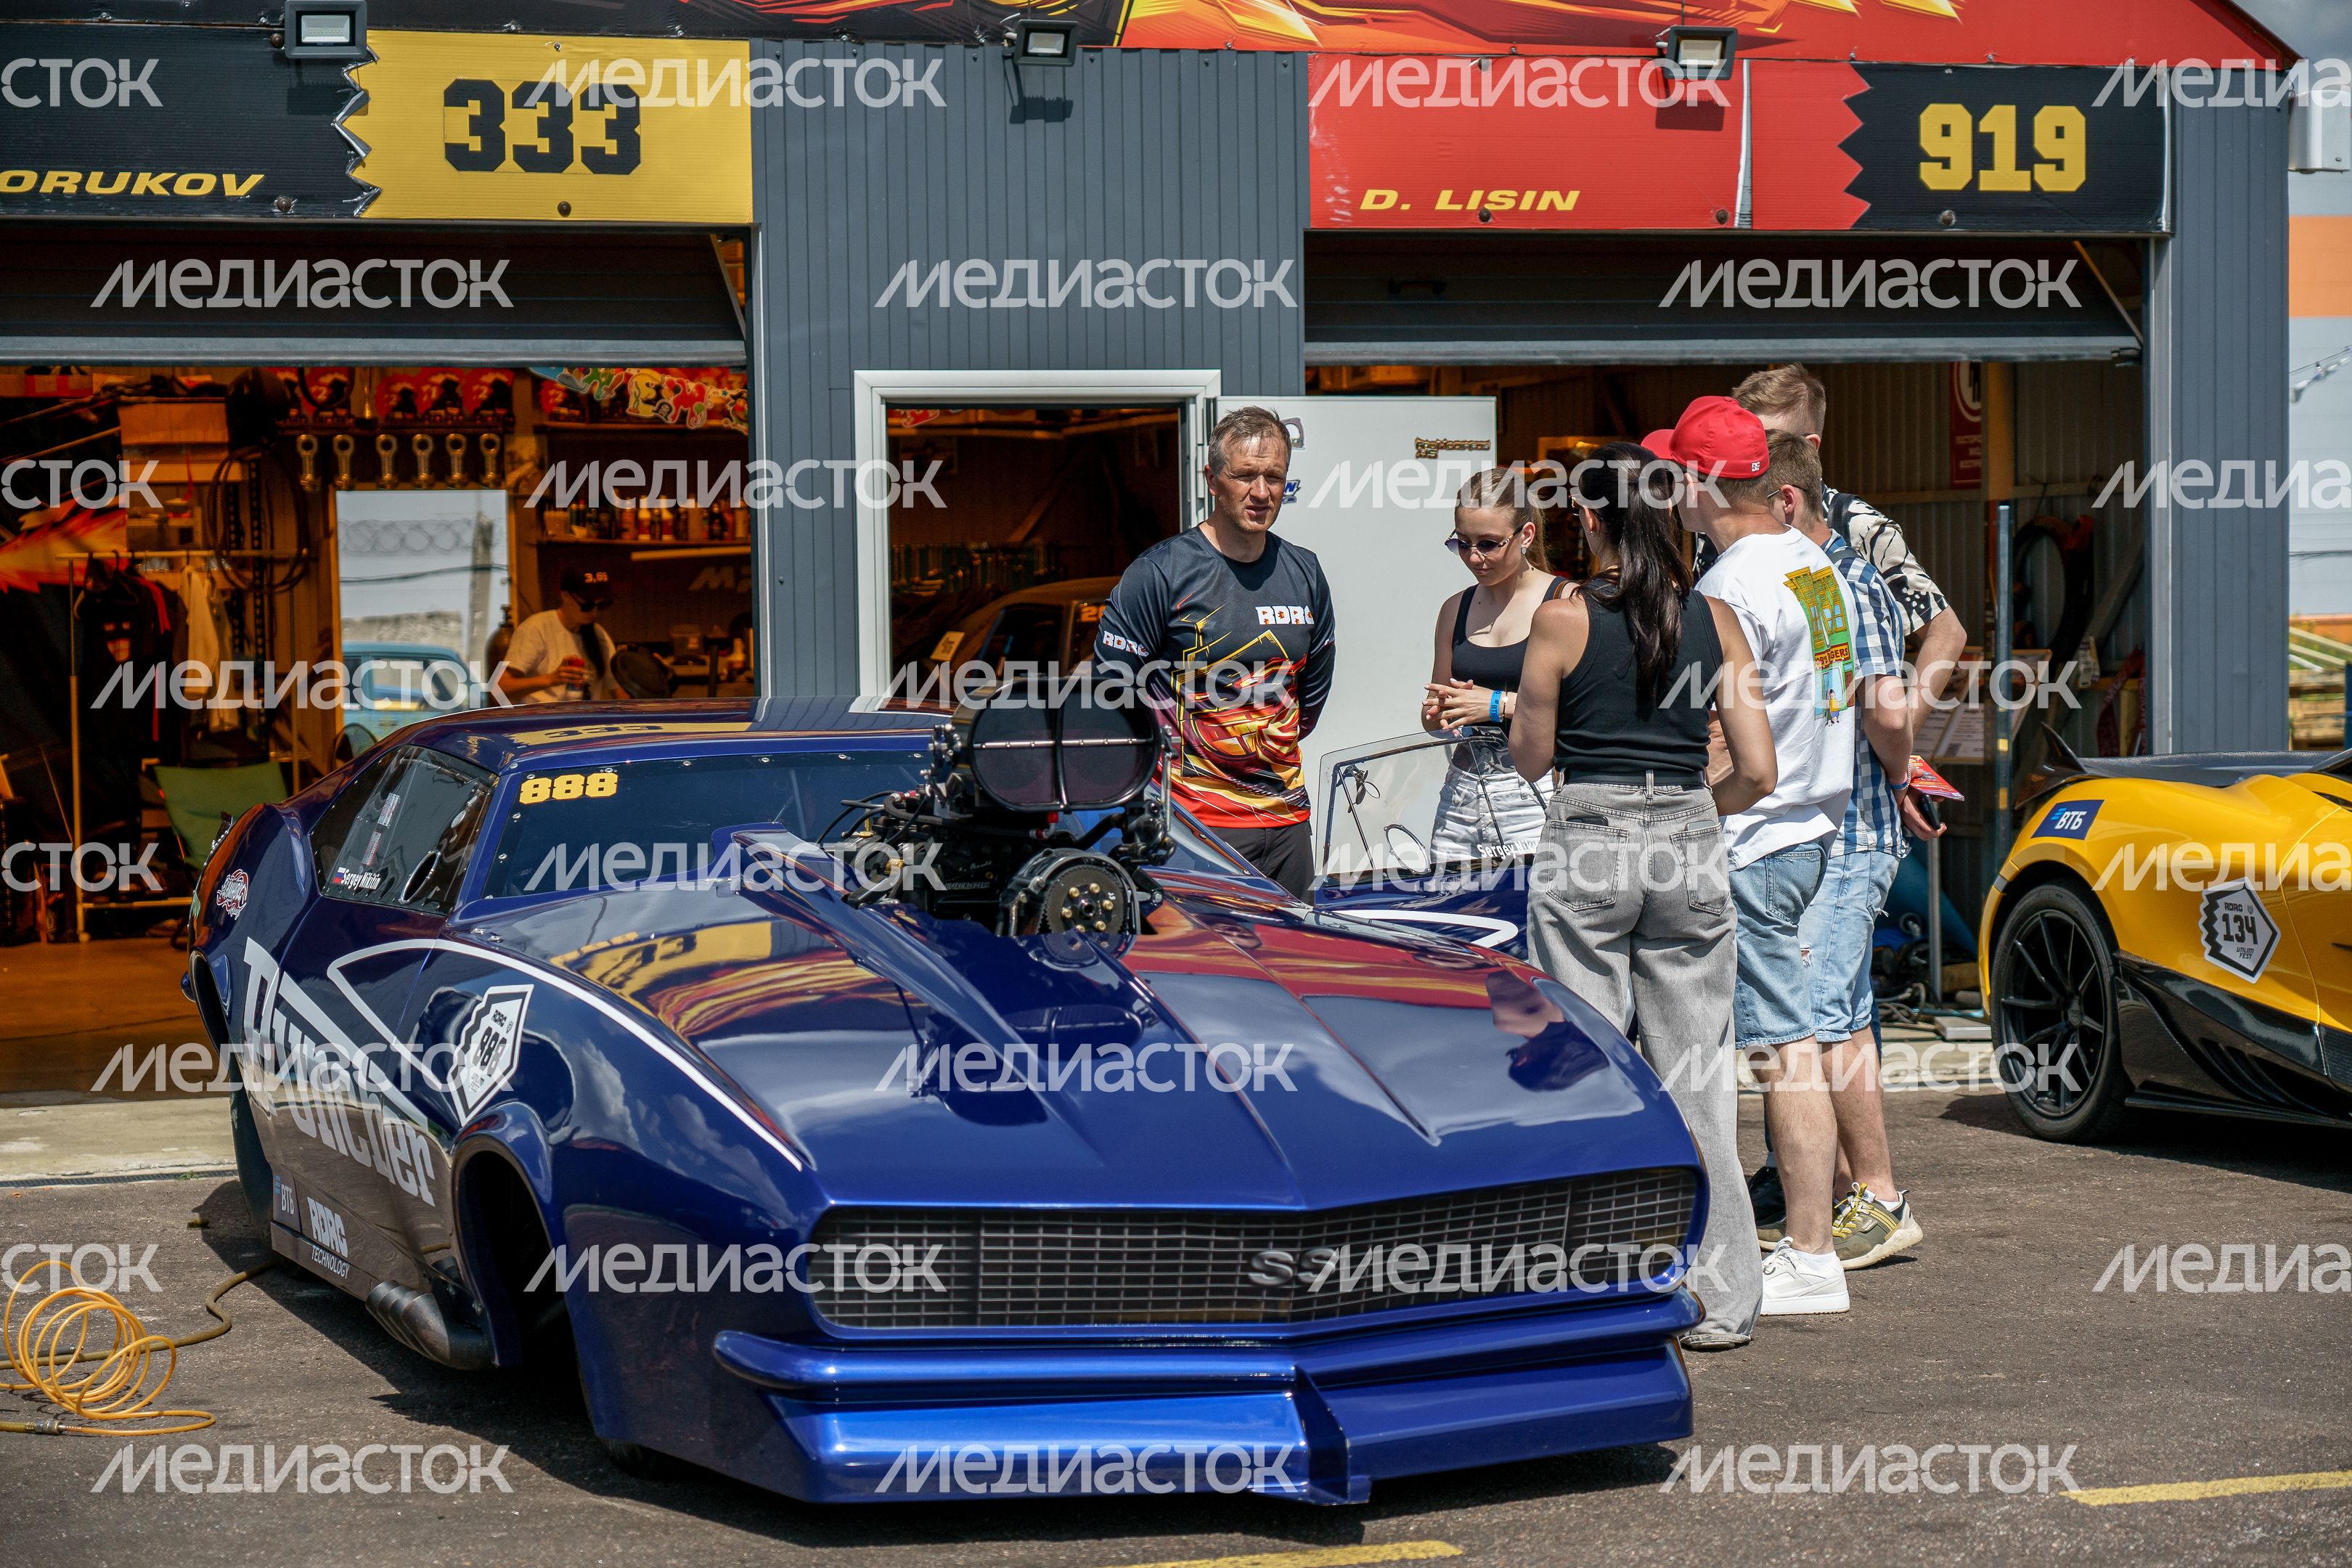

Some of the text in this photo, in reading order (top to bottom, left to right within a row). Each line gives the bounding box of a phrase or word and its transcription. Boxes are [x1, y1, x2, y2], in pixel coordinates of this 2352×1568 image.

[444, 79, 642, 175] 333
[1919, 103, 2086, 192] 919
[0, 170, 265, 197] ORUKOV
[1359, 189, 1580, 212] D. LISIN
[519, 772, 618, 804] 888
[2054, 808, 2088, 830] ВТБ
[1477, 844, 1516, 860] Sergey
[340, 868, 382, 891] Sergey Nikitin
[2224, 902, 2243, 912] RDRC
[2222, 912, 2258, 945] 134
[473, 1026, 507, 1077] 888
[281, 1183, 295, 1215] ВТБ
[306, 1196, 349, 1258] RDRC
[311, 1245, 350, 1280] TECHNOLOGY
